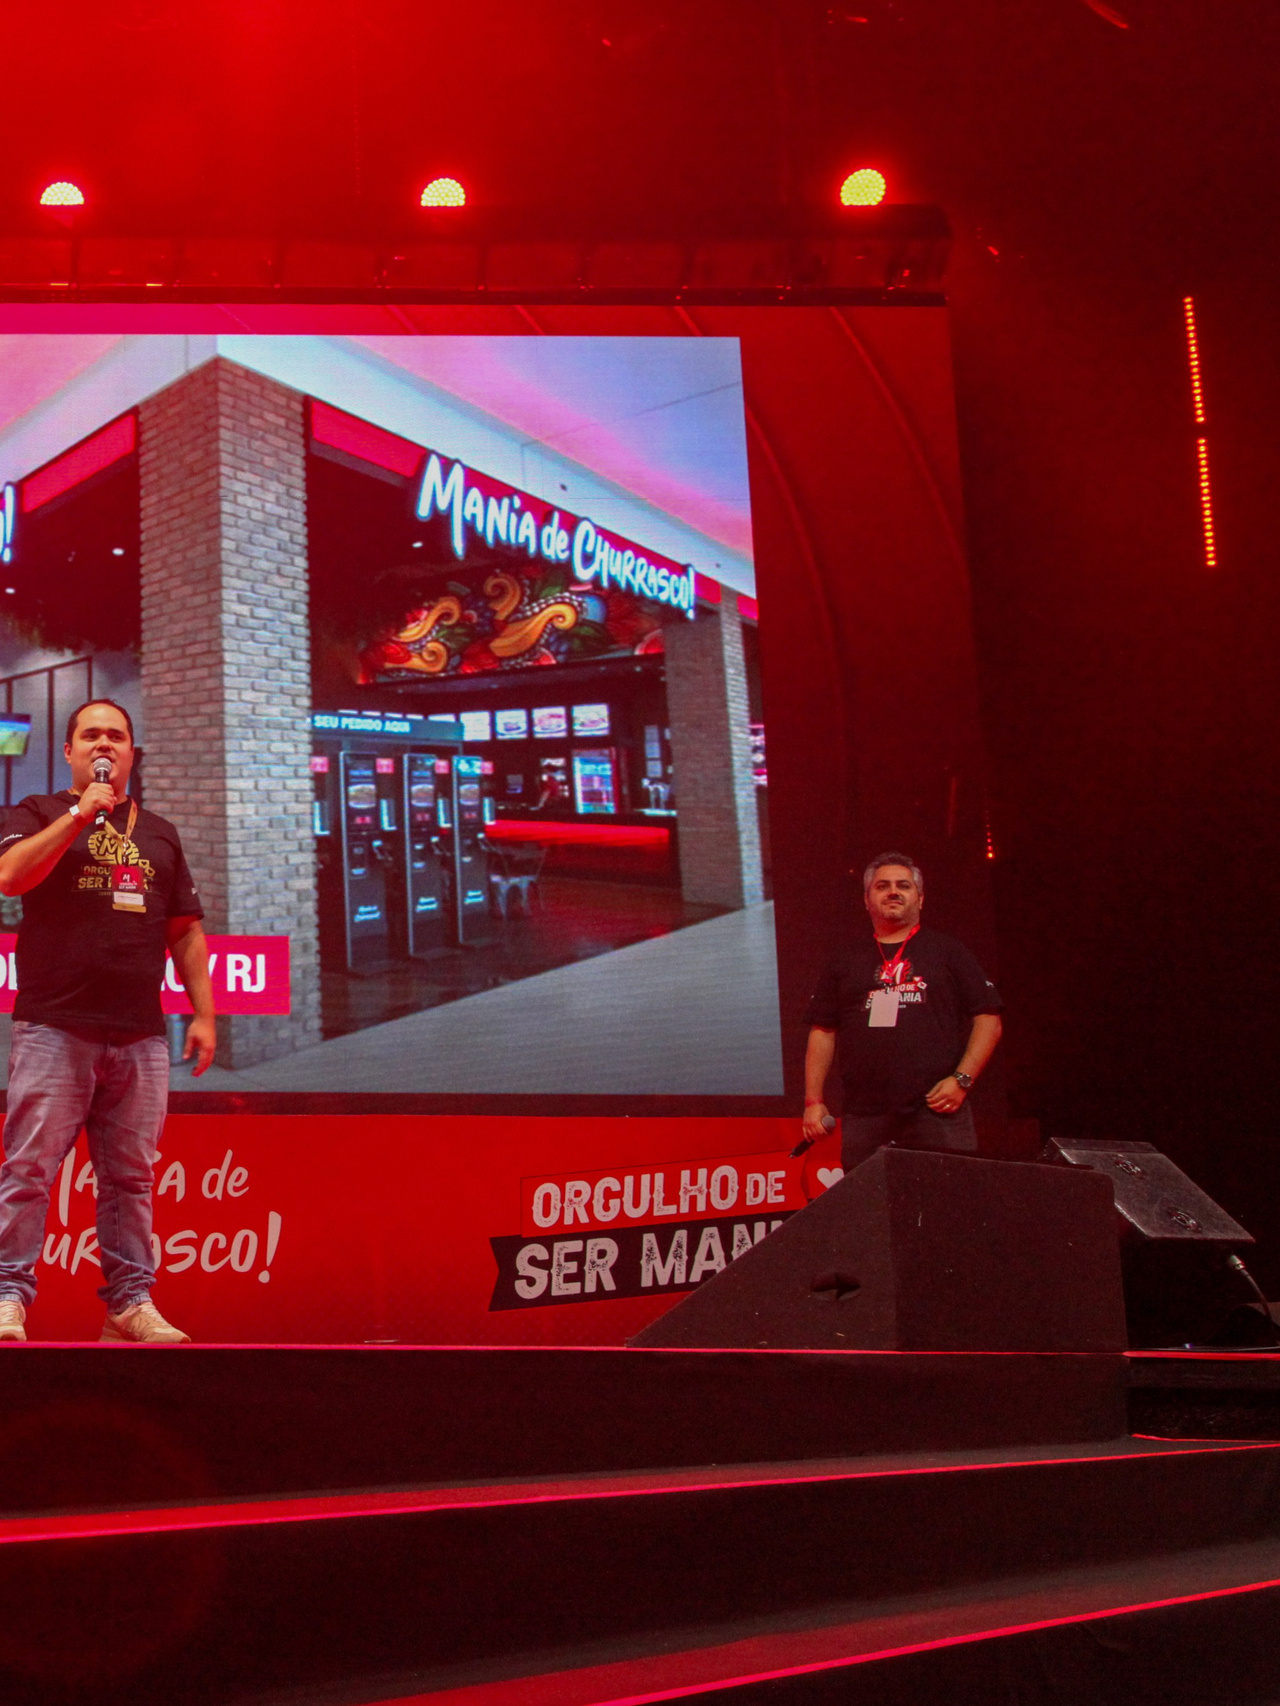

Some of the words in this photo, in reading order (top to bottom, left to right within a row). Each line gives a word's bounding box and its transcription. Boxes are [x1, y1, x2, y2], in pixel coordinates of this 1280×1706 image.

[541, 510, 569, 561] de
[78, 877, 104, 889] SER
[226, 953, 266, 993] RJ
[201, 1149, 249, 1201] de
[532, 1164, 739, 1228] ORGULHO
[745, 1170, 786, 1206] DE
[514, 1237, 619, 1300] SER
[641, 1220, 783, 1288] MAN
